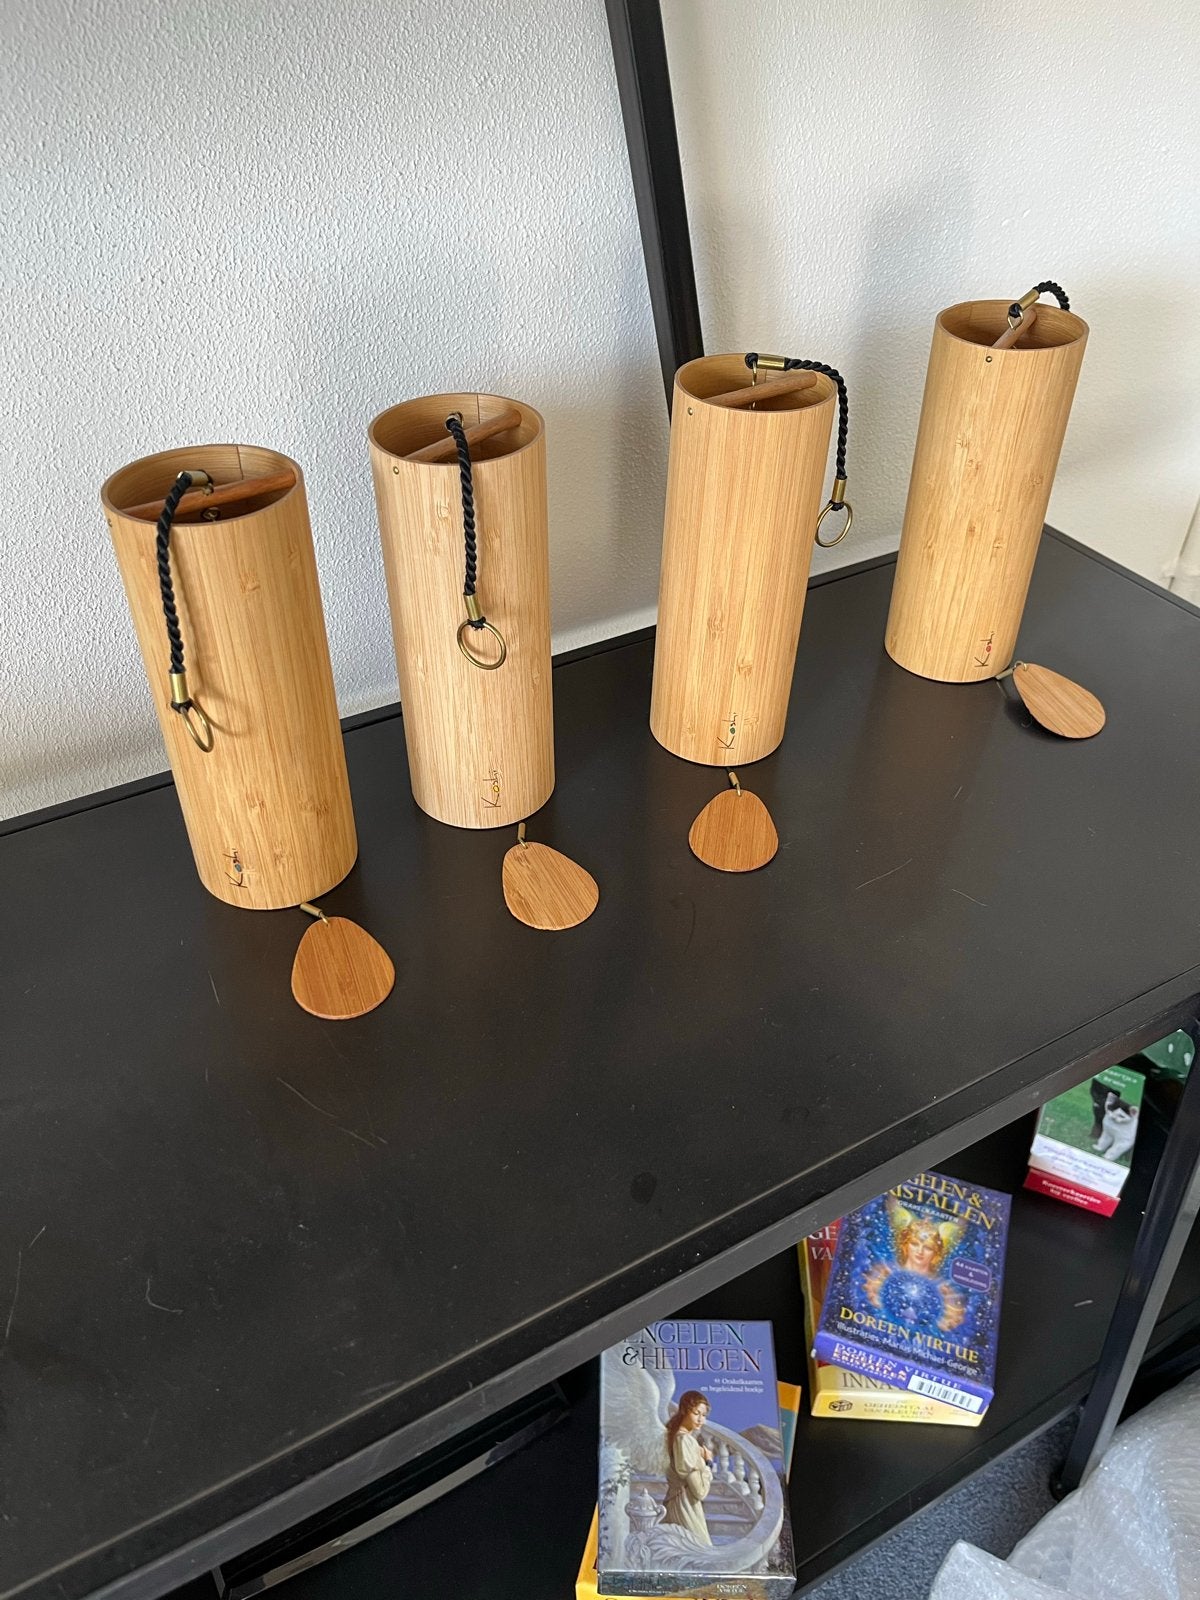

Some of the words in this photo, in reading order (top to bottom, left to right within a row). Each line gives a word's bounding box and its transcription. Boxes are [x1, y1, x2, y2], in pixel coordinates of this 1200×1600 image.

[969, 1192, 983, 1208] &
[840, 1306, 911, 1341] DOREEN
[914, 1331, 979, 1364] VIRTUE
[835, 1342, 898, 1369] DOREEN
